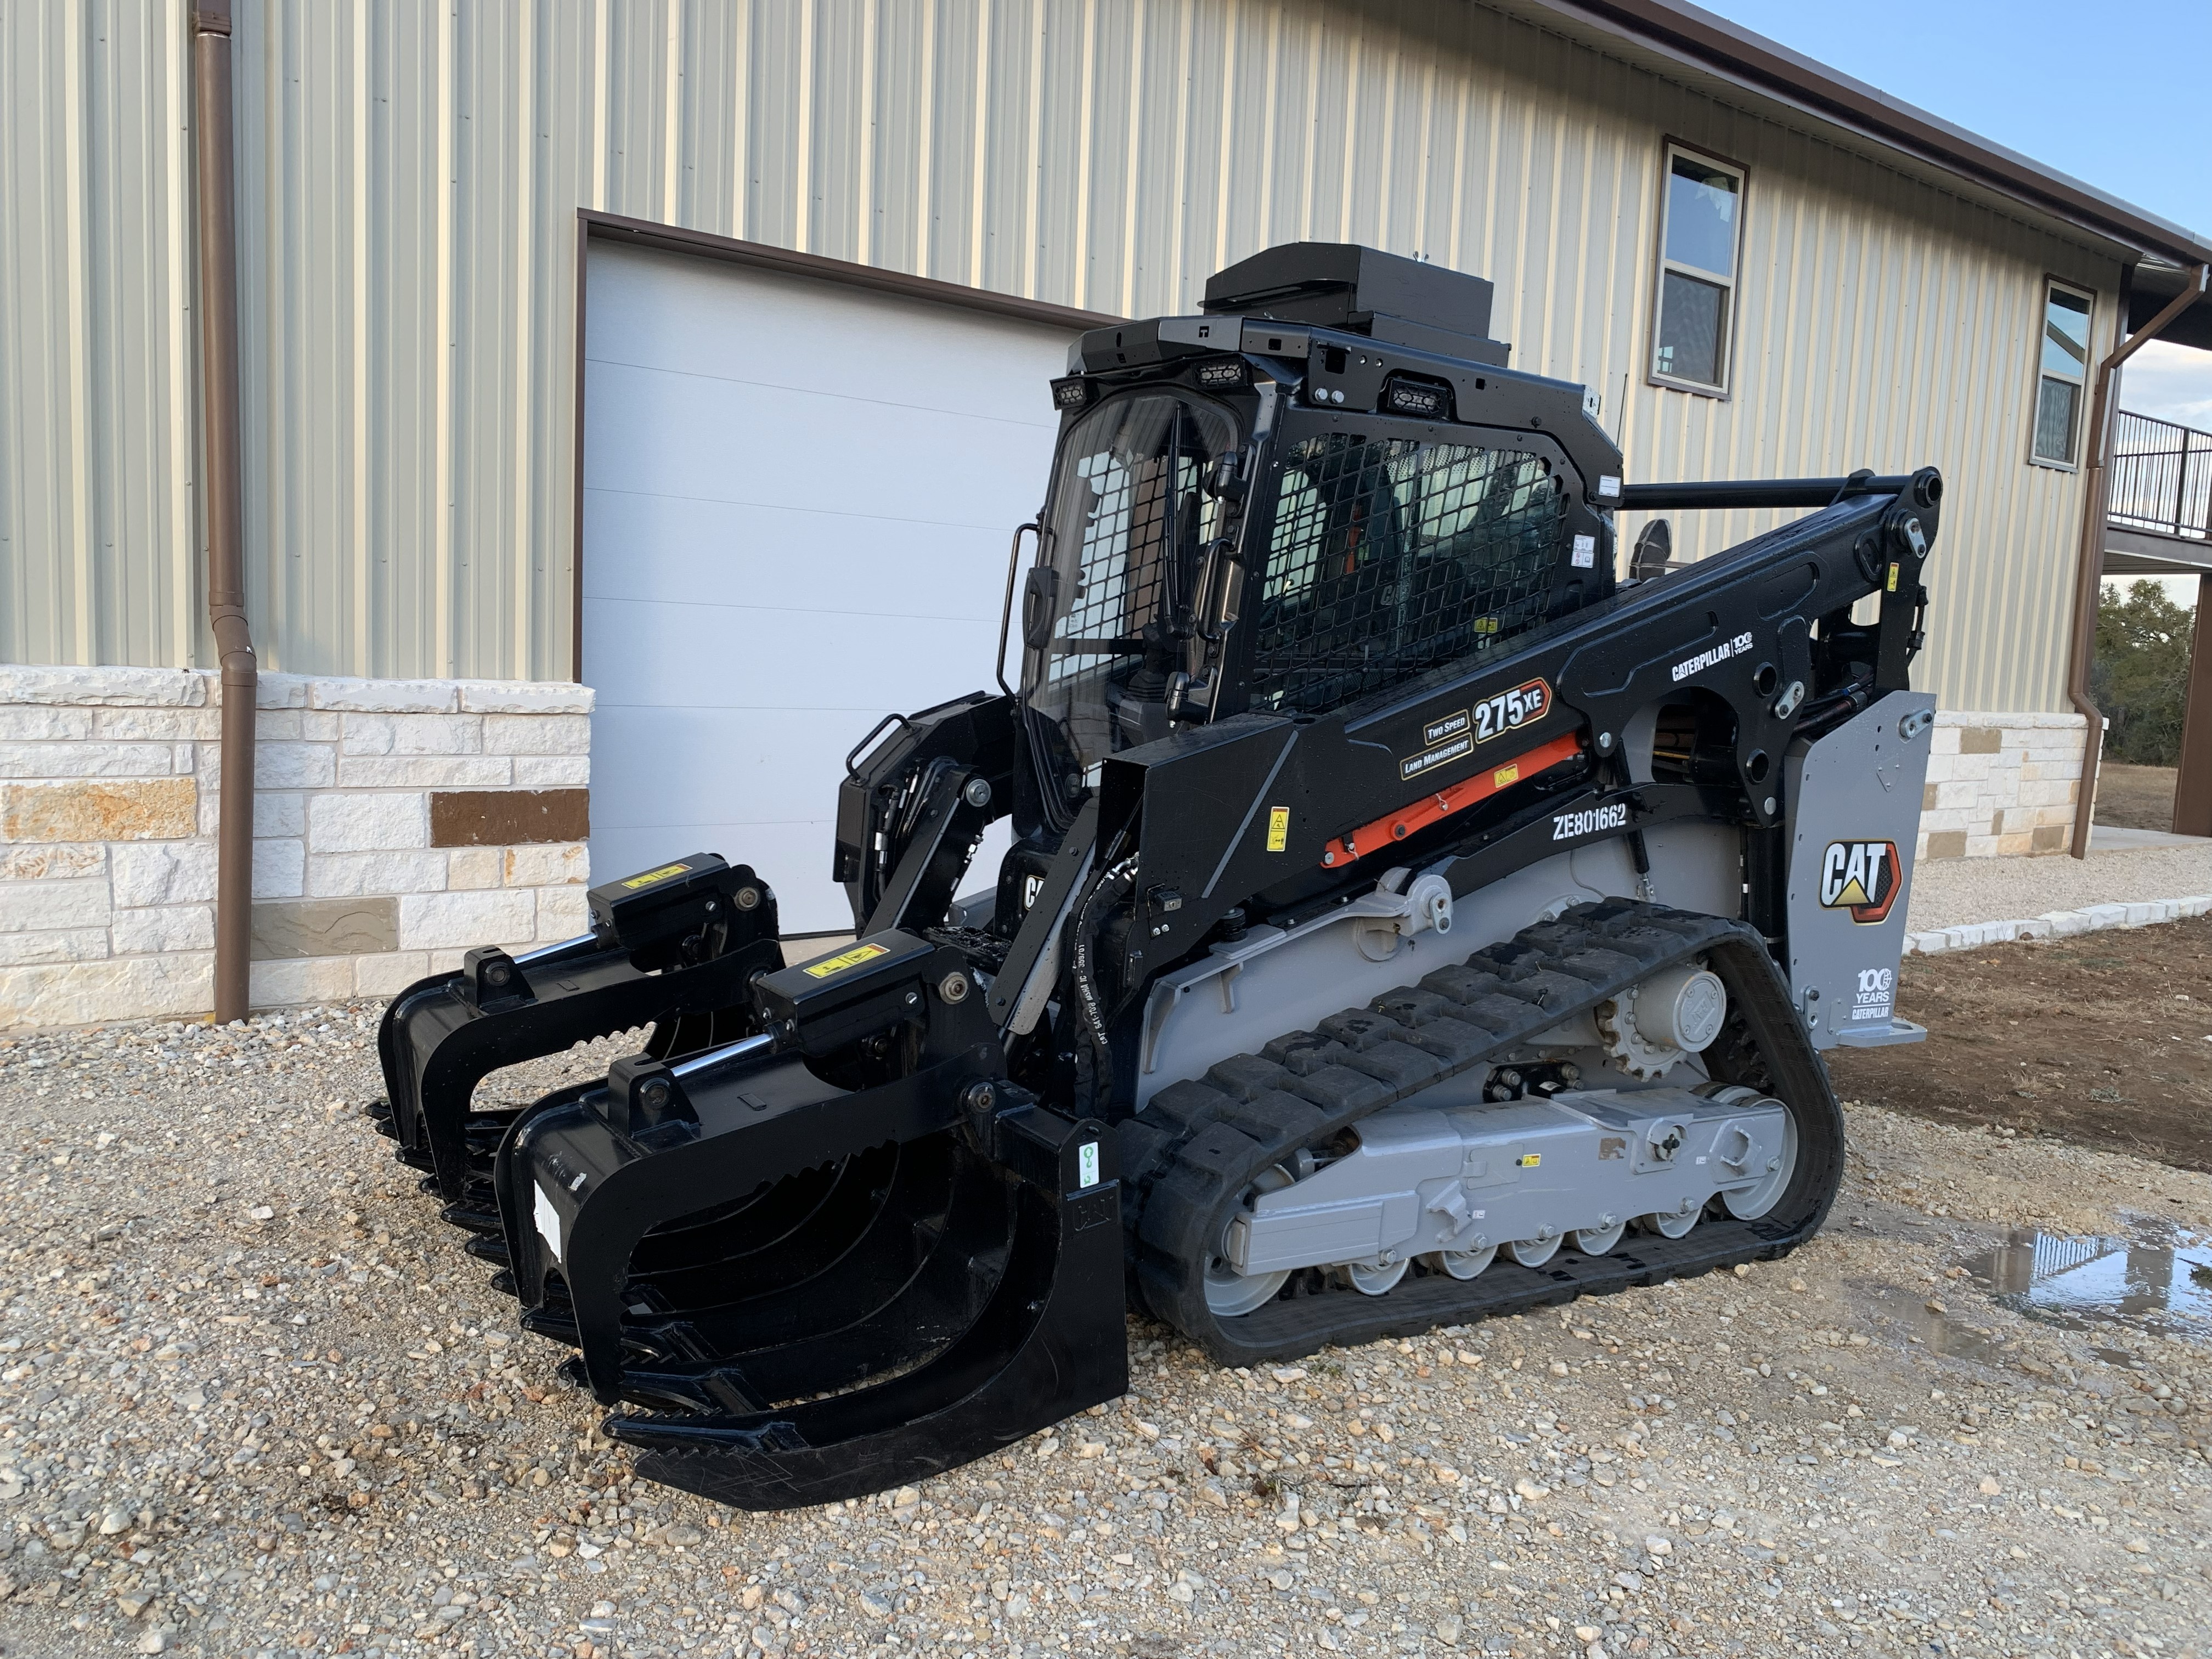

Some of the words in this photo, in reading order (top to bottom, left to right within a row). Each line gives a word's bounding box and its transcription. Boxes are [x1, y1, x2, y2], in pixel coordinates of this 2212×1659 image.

[1734, 642, 1753, 655] YEARS
[1672, 642, 1731, 682] CATERPILLAR
[1553, 803, 1626, 840] ZE801662
[1821, 843, 1887, 906] CAT
[1858, 968, 1893, 992] 100
[1080, 984, 1093, 1001] MSHA
[1855, 991, 1889, 1004] YEARS
[1852, 1006, 1889, 1020] CATERPILLAR
